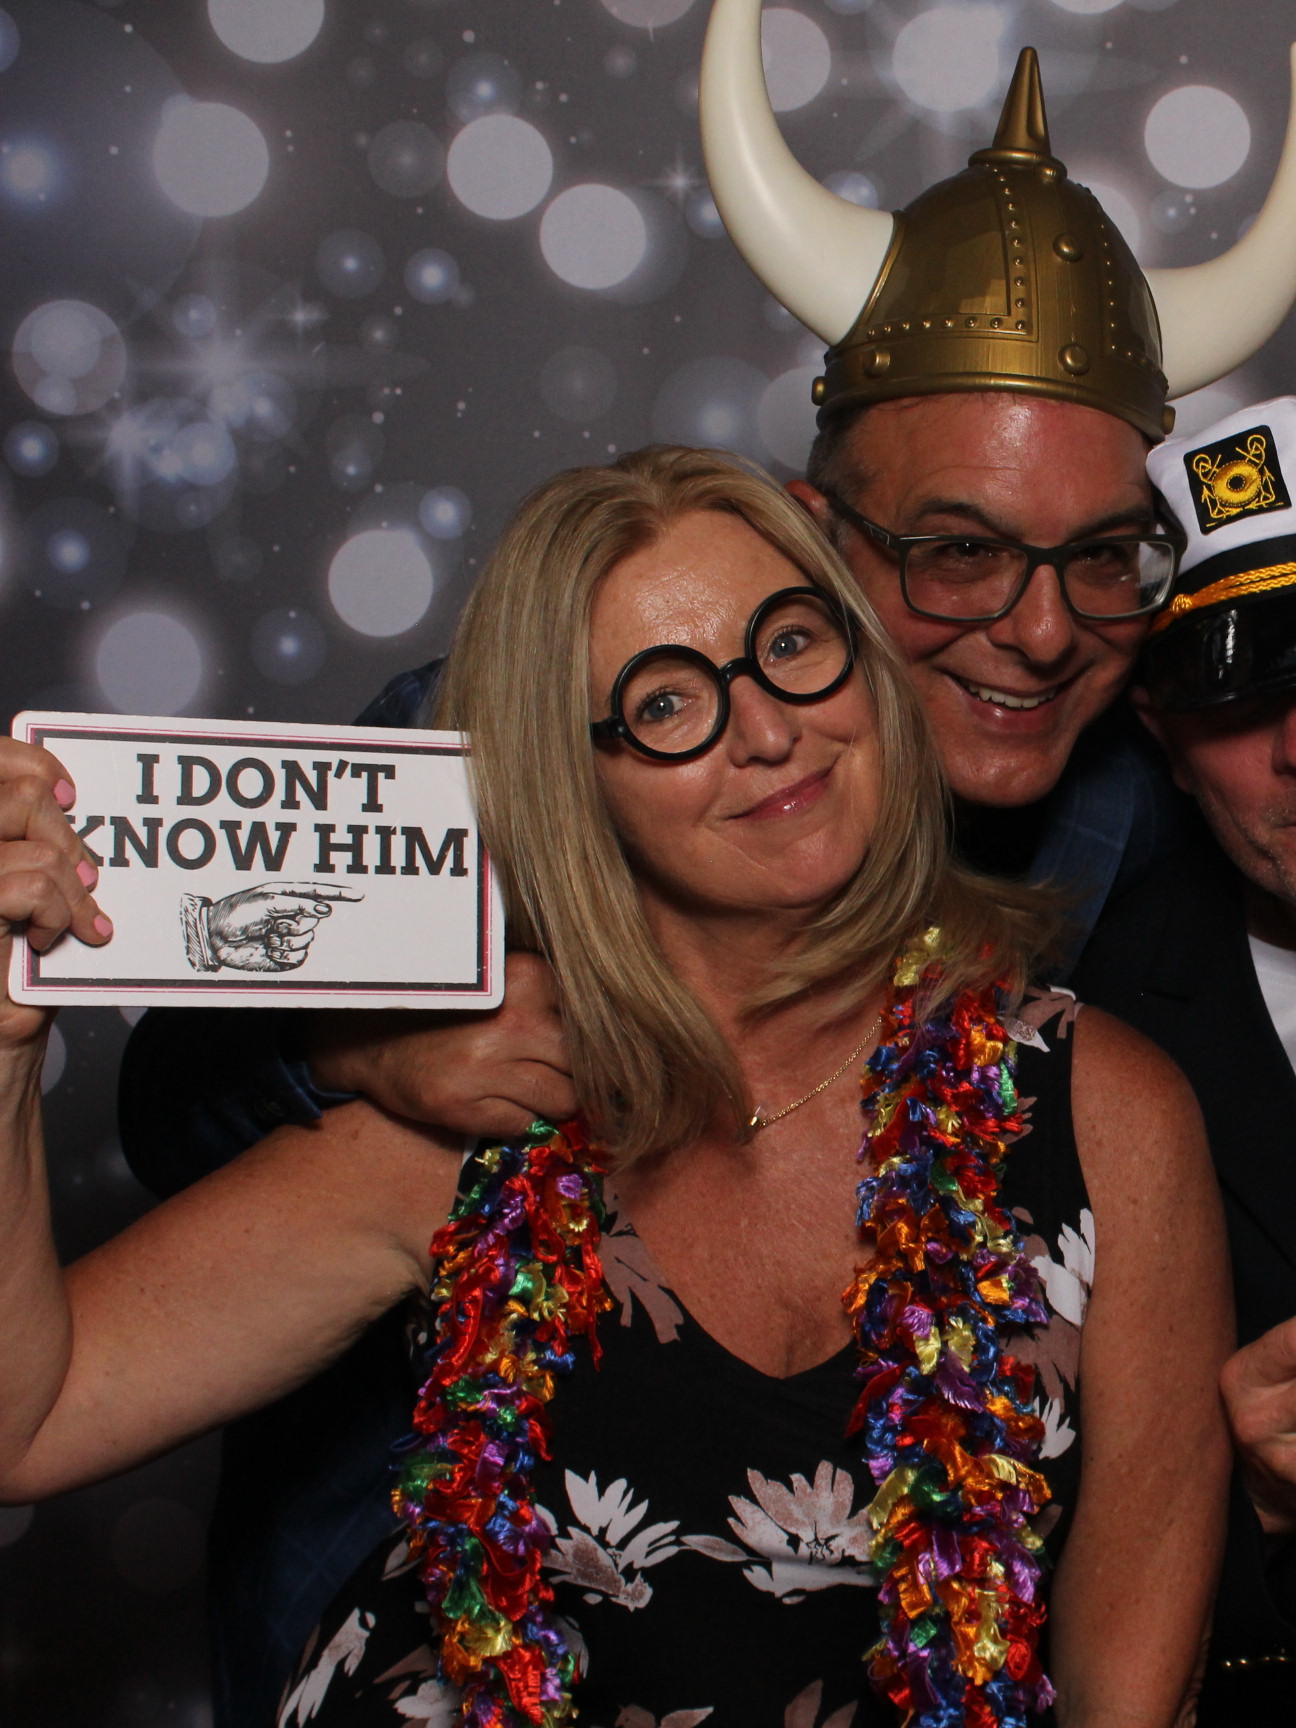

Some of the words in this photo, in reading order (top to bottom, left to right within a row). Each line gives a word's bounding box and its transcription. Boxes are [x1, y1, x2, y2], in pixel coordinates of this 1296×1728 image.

[136, 753, 160, 805] I
[176, 754, 396, 814] DON'T
[313, 823, 469, 877] HIM
